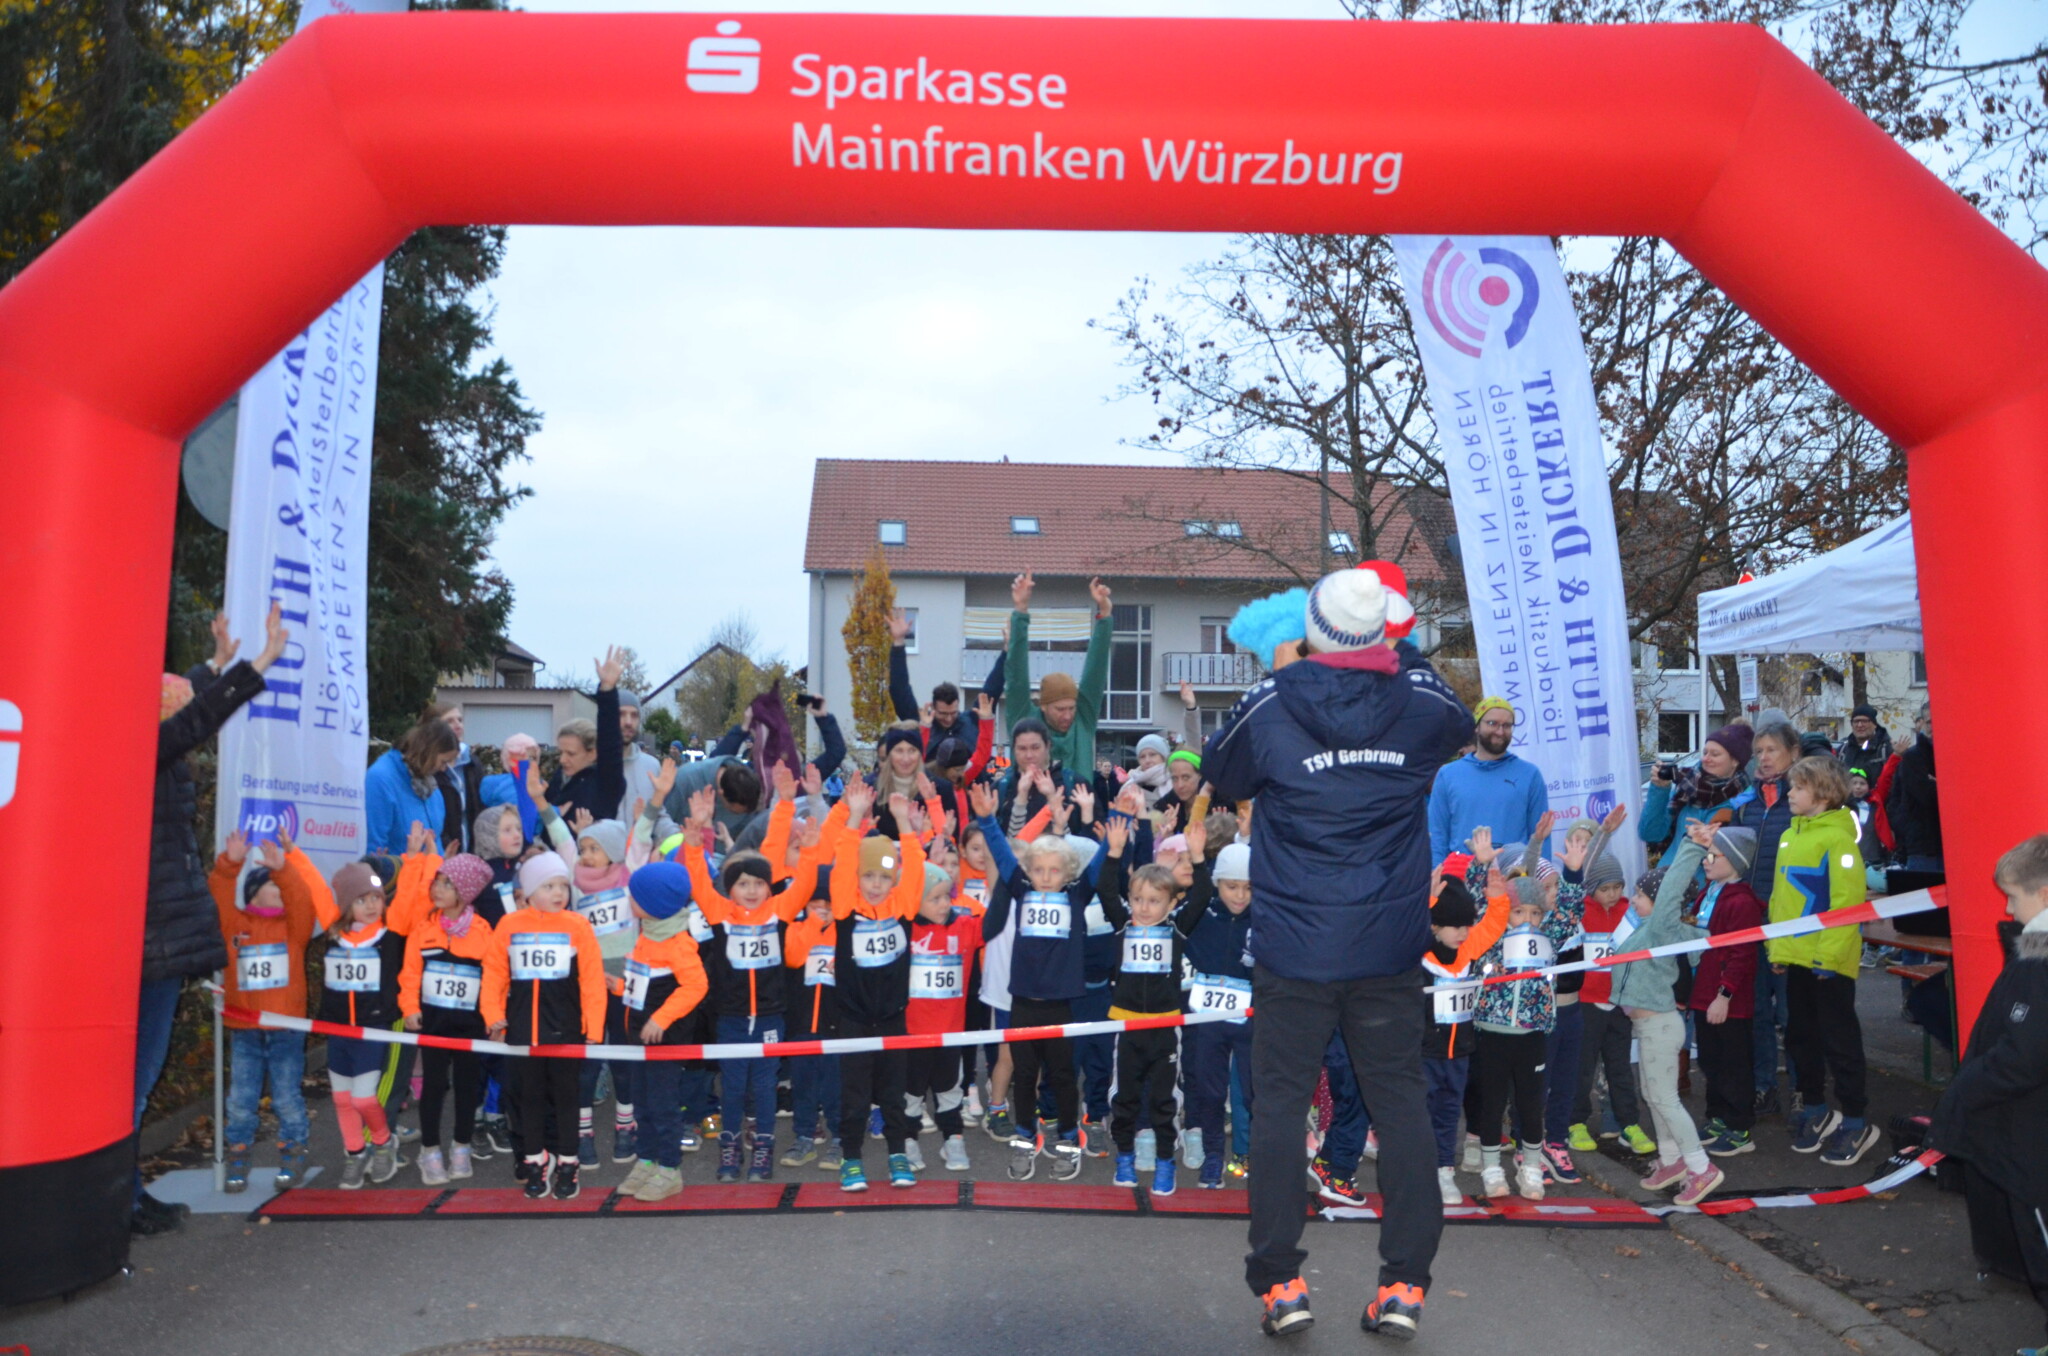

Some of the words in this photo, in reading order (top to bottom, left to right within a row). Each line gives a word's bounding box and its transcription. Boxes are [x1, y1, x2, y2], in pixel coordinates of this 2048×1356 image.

[790, 53, 1068, 110] Sparkasse
[791, 122, 1126, 181] Mainfranken
[1142, 137, 1404, 195] Würzburg
[342, 434, 361, 476] IN
[278, 502, 307, 538] &
[331, 497, 363, 736] KOMPETENZ
[1303, 751, 1334, 774] TSV
[1338, 749, 1406, 766] Gerbrunn
[242, 773, 299, 796] Beratung
[302, 782, 320, 795] und
[322, 782, 358, 799] Service
[244, 813, 278, 833] HD
[303, 818, 358, 839] Qualitä
[588, 905, 618, 927] 437
[1027, 908, 1060, 926] 380
[739, 939, 770, 958] 126
[865, 933, 898, 955] 439
[1130, 943, 1163, 961] 198
[1527, 939, 1538, 956] 8
[520, 949, 556, 967] 166
[248, 961, 272, 979] 48
[335, 963, 367, 981] 130
[924, 970, 955, 988] 156
[434, 977, 467, 998] 138
[1202, 990, 1238, 1011] 378
[1449, 993, 1474, 1012] 118
